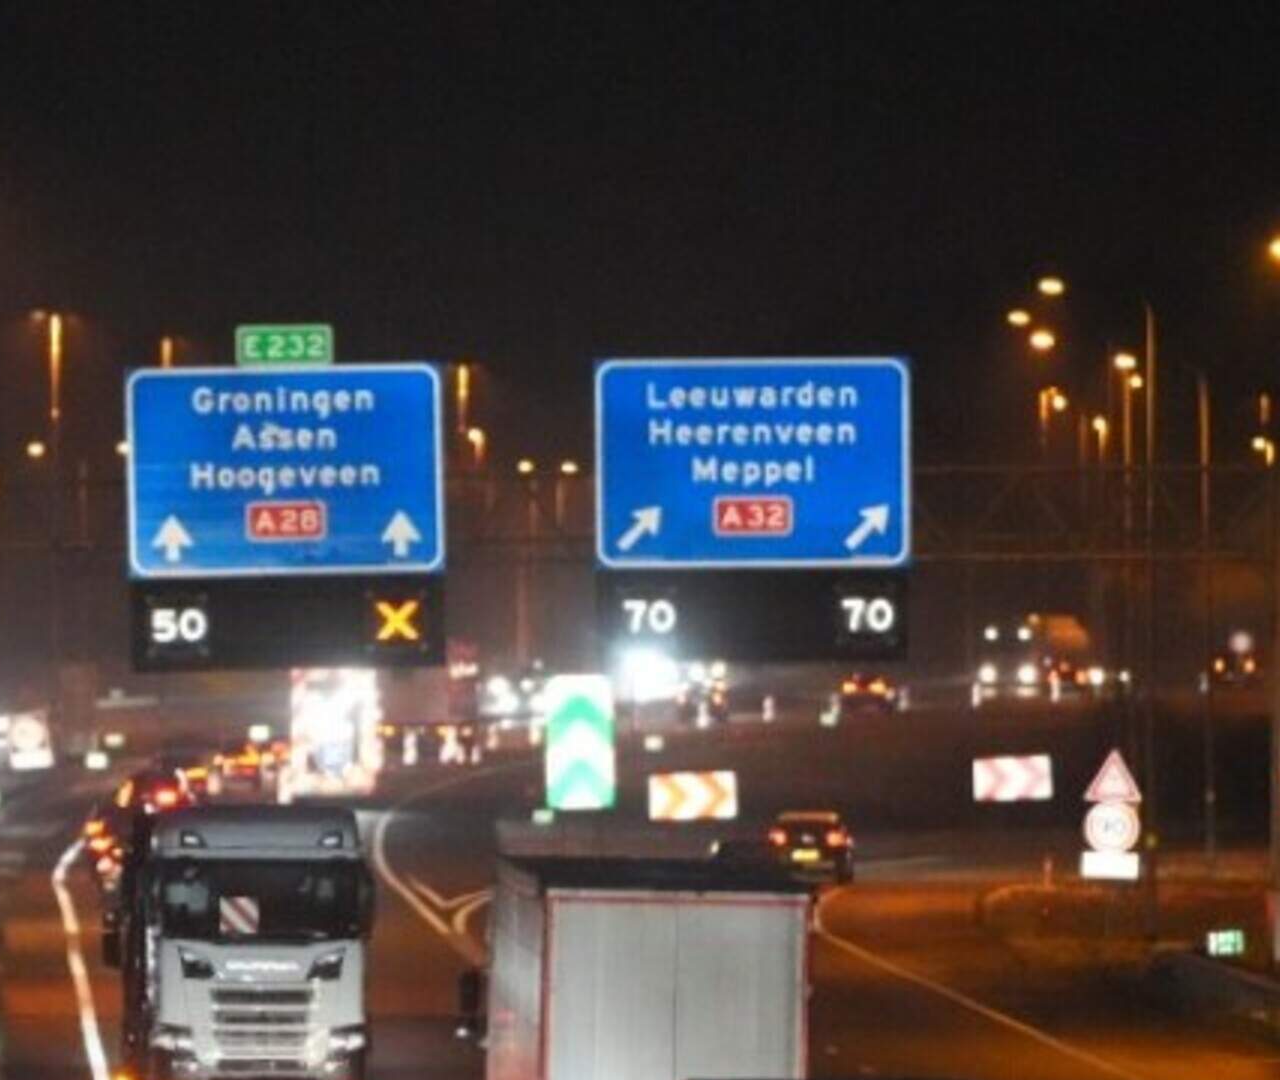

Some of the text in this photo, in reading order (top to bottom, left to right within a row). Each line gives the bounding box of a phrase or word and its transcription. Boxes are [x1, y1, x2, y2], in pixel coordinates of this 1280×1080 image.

[191, 386, 375, 420] Groningen
[646, 381, 858, 409] Leeuwarden
[231, 424, 338, 451] Assen
[648, 418, 857, 446] Heerenveen
[189, 462, 381, 495] Hoogeveen
[691, 455, 815, 487] Meppel
[255, 508, 319, 533] A28
[721, 504, 785, 528] A32
[150, 608, 208, 643] 50
[623, 599, 677, 634] 70
[840, 598, 895, 632] 70
